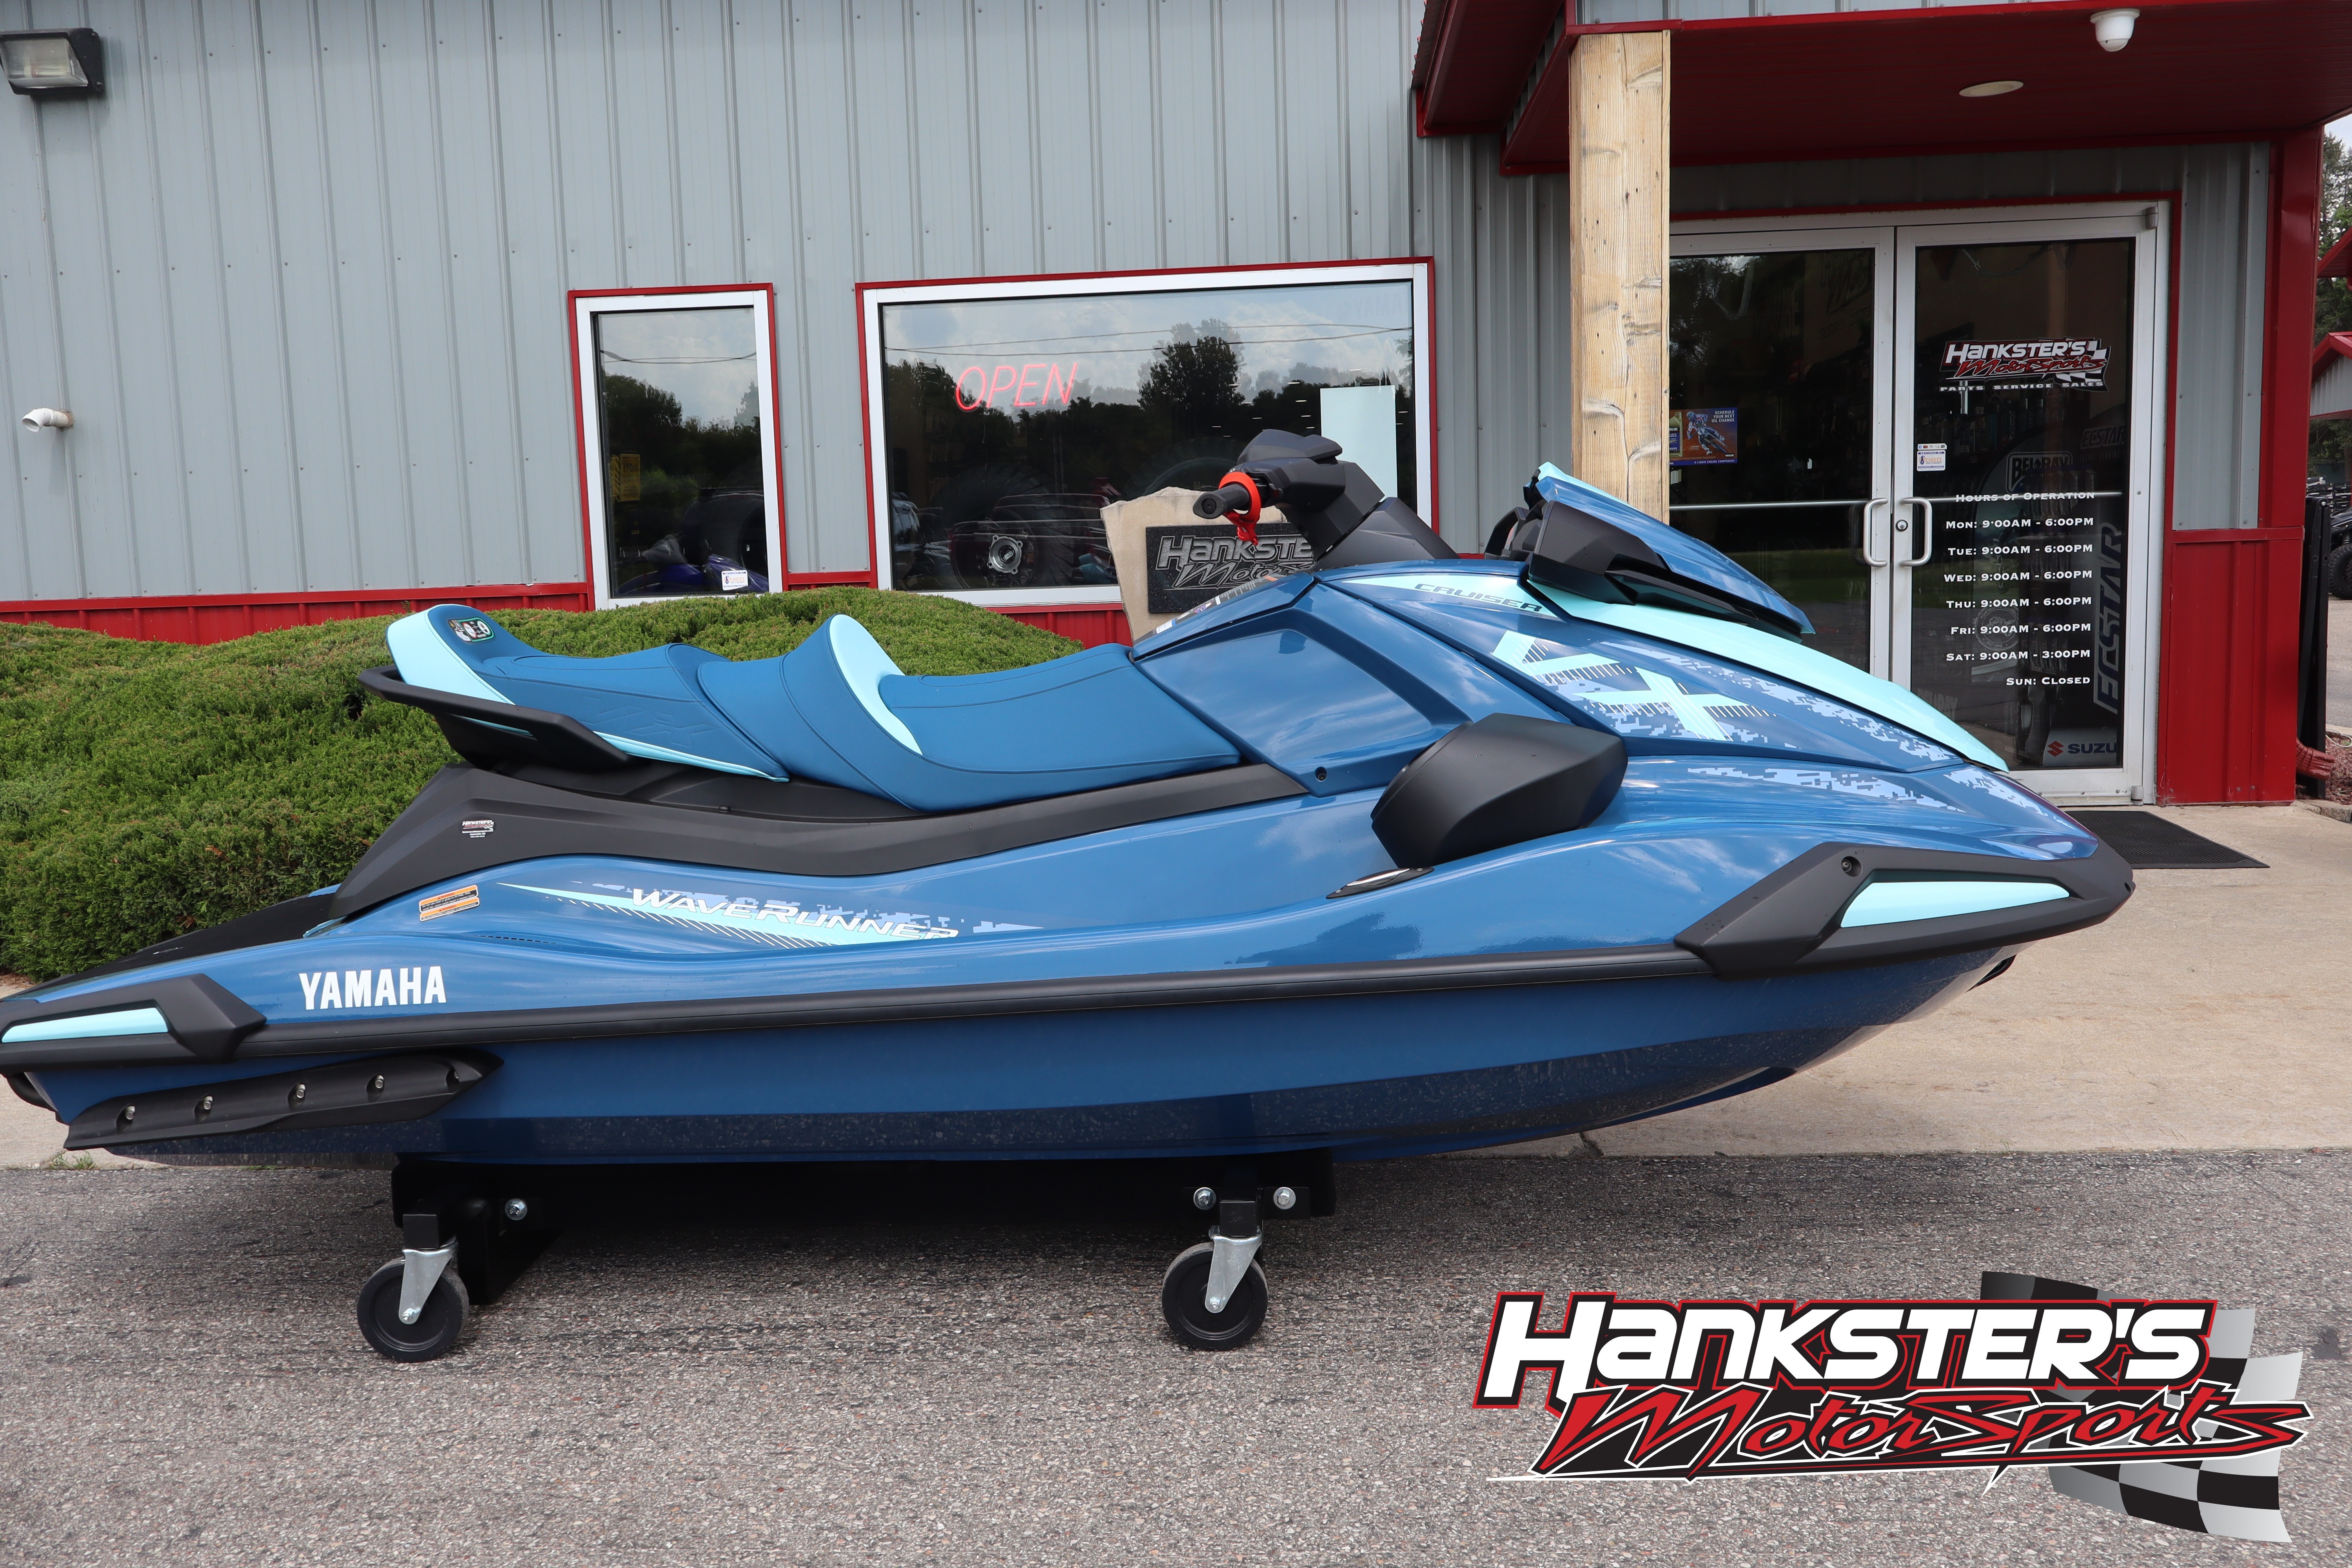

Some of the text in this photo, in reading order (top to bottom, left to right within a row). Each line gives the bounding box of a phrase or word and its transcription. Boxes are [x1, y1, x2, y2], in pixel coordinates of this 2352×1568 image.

[954, 361, 1078, 412] OPEN
[1956, 492, 2095, 502] HOURS OF OPERATION
[1946, 521, 1977, 529] MON:
[2045, 518, 2094, 526] 6:00PM
[1982, 546, 2031, 555] 9:00AM
[2044, 544, 2093, 553] 6:00PM
[1944, 574, 1976, 583] WED:
[1981, 572, 2030, 581] 9:00AM
[2043, 570, 2092, 579] 6:00PM
[1414, 583, 1543, 612] CRUISER
[1946, 600, 1976, 608] THU:
[1980, 599, 2029, 608] 9:00AM
[2043, 597, 2092, 606] 6:00PM
[1980, 625, 2029, 634] 9:00AM
[2043, 623, 2091, 632] 6:00PM
[1946, 653, 1975, 661] SAT:
[1980, 652, 2028, 660] 9:00AM
[2042, 650, 2091, 659] 3:00PM
[1491, 630, 1756, 742] VX
[2006, 677, 2036, 686] SUN:
[632, 887, 960, 940] WAVERUNNER
[299, 966, 447, 1010] YAMAHA
